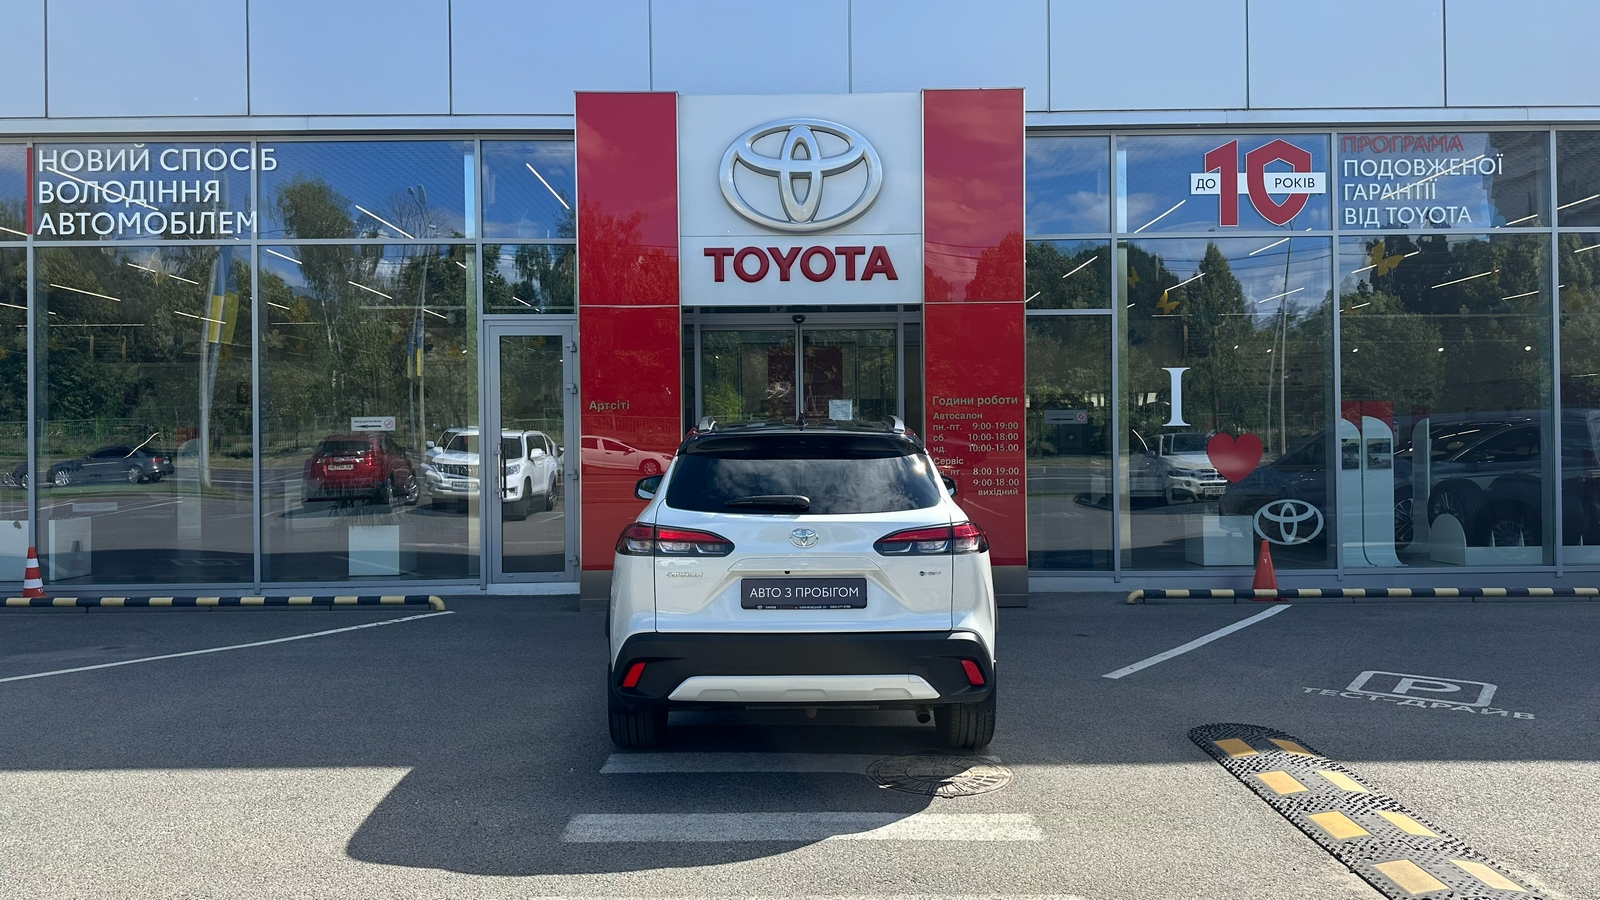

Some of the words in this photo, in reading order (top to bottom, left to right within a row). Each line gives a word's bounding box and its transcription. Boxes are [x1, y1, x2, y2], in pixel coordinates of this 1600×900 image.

[1342, 134, 1464, 153] ПРОГРАМА
[38, 143, 150, 172] НОВИЙ
[159, 147, 278, 171] СПОСІБ
[1343, 154, 1504, 180] ПОДОВЖЕНОЇ
[1195, 178, 1216, 193] ДО
[1274, 177, 1316, 189] РОКІВ
[1343, 178, 1437, 201] ГАРАНТІЇ
[38, 180, 220, 208] ВОЛОДІННЯ
[37, 211, 257, 236] АВТОМОБІЛЕМ
[1344, 207, 1380, 228] ВІД
[1387, 205, 1472, 225] TOYOTA
[704, 246, 899, 283] TOYOTA
[932, 396, 974, 407] Години
[977, 395, 1018, 407] роботи
[1161, 366, 1191, 427] I
[589, 400, 630, 412] Артсіті
[933, 412, 983, 420] Автосалон
[968, 433, 1018, 441] 10:00-18:00
[968, 443, 1019, 452] 10:00-15:00
[933, 456, 964, 466] Сервіс
[972, 478, 1019, 487] 9:00-18:00
[978, 487, 1018, 496] вихідний
[750, 587, 782, 598] АВТО
[795, 586, 859, 598] ПРОБІГОМ
[1302, 686, 1536, 720] ТЕСТ-ДРАЙВ
